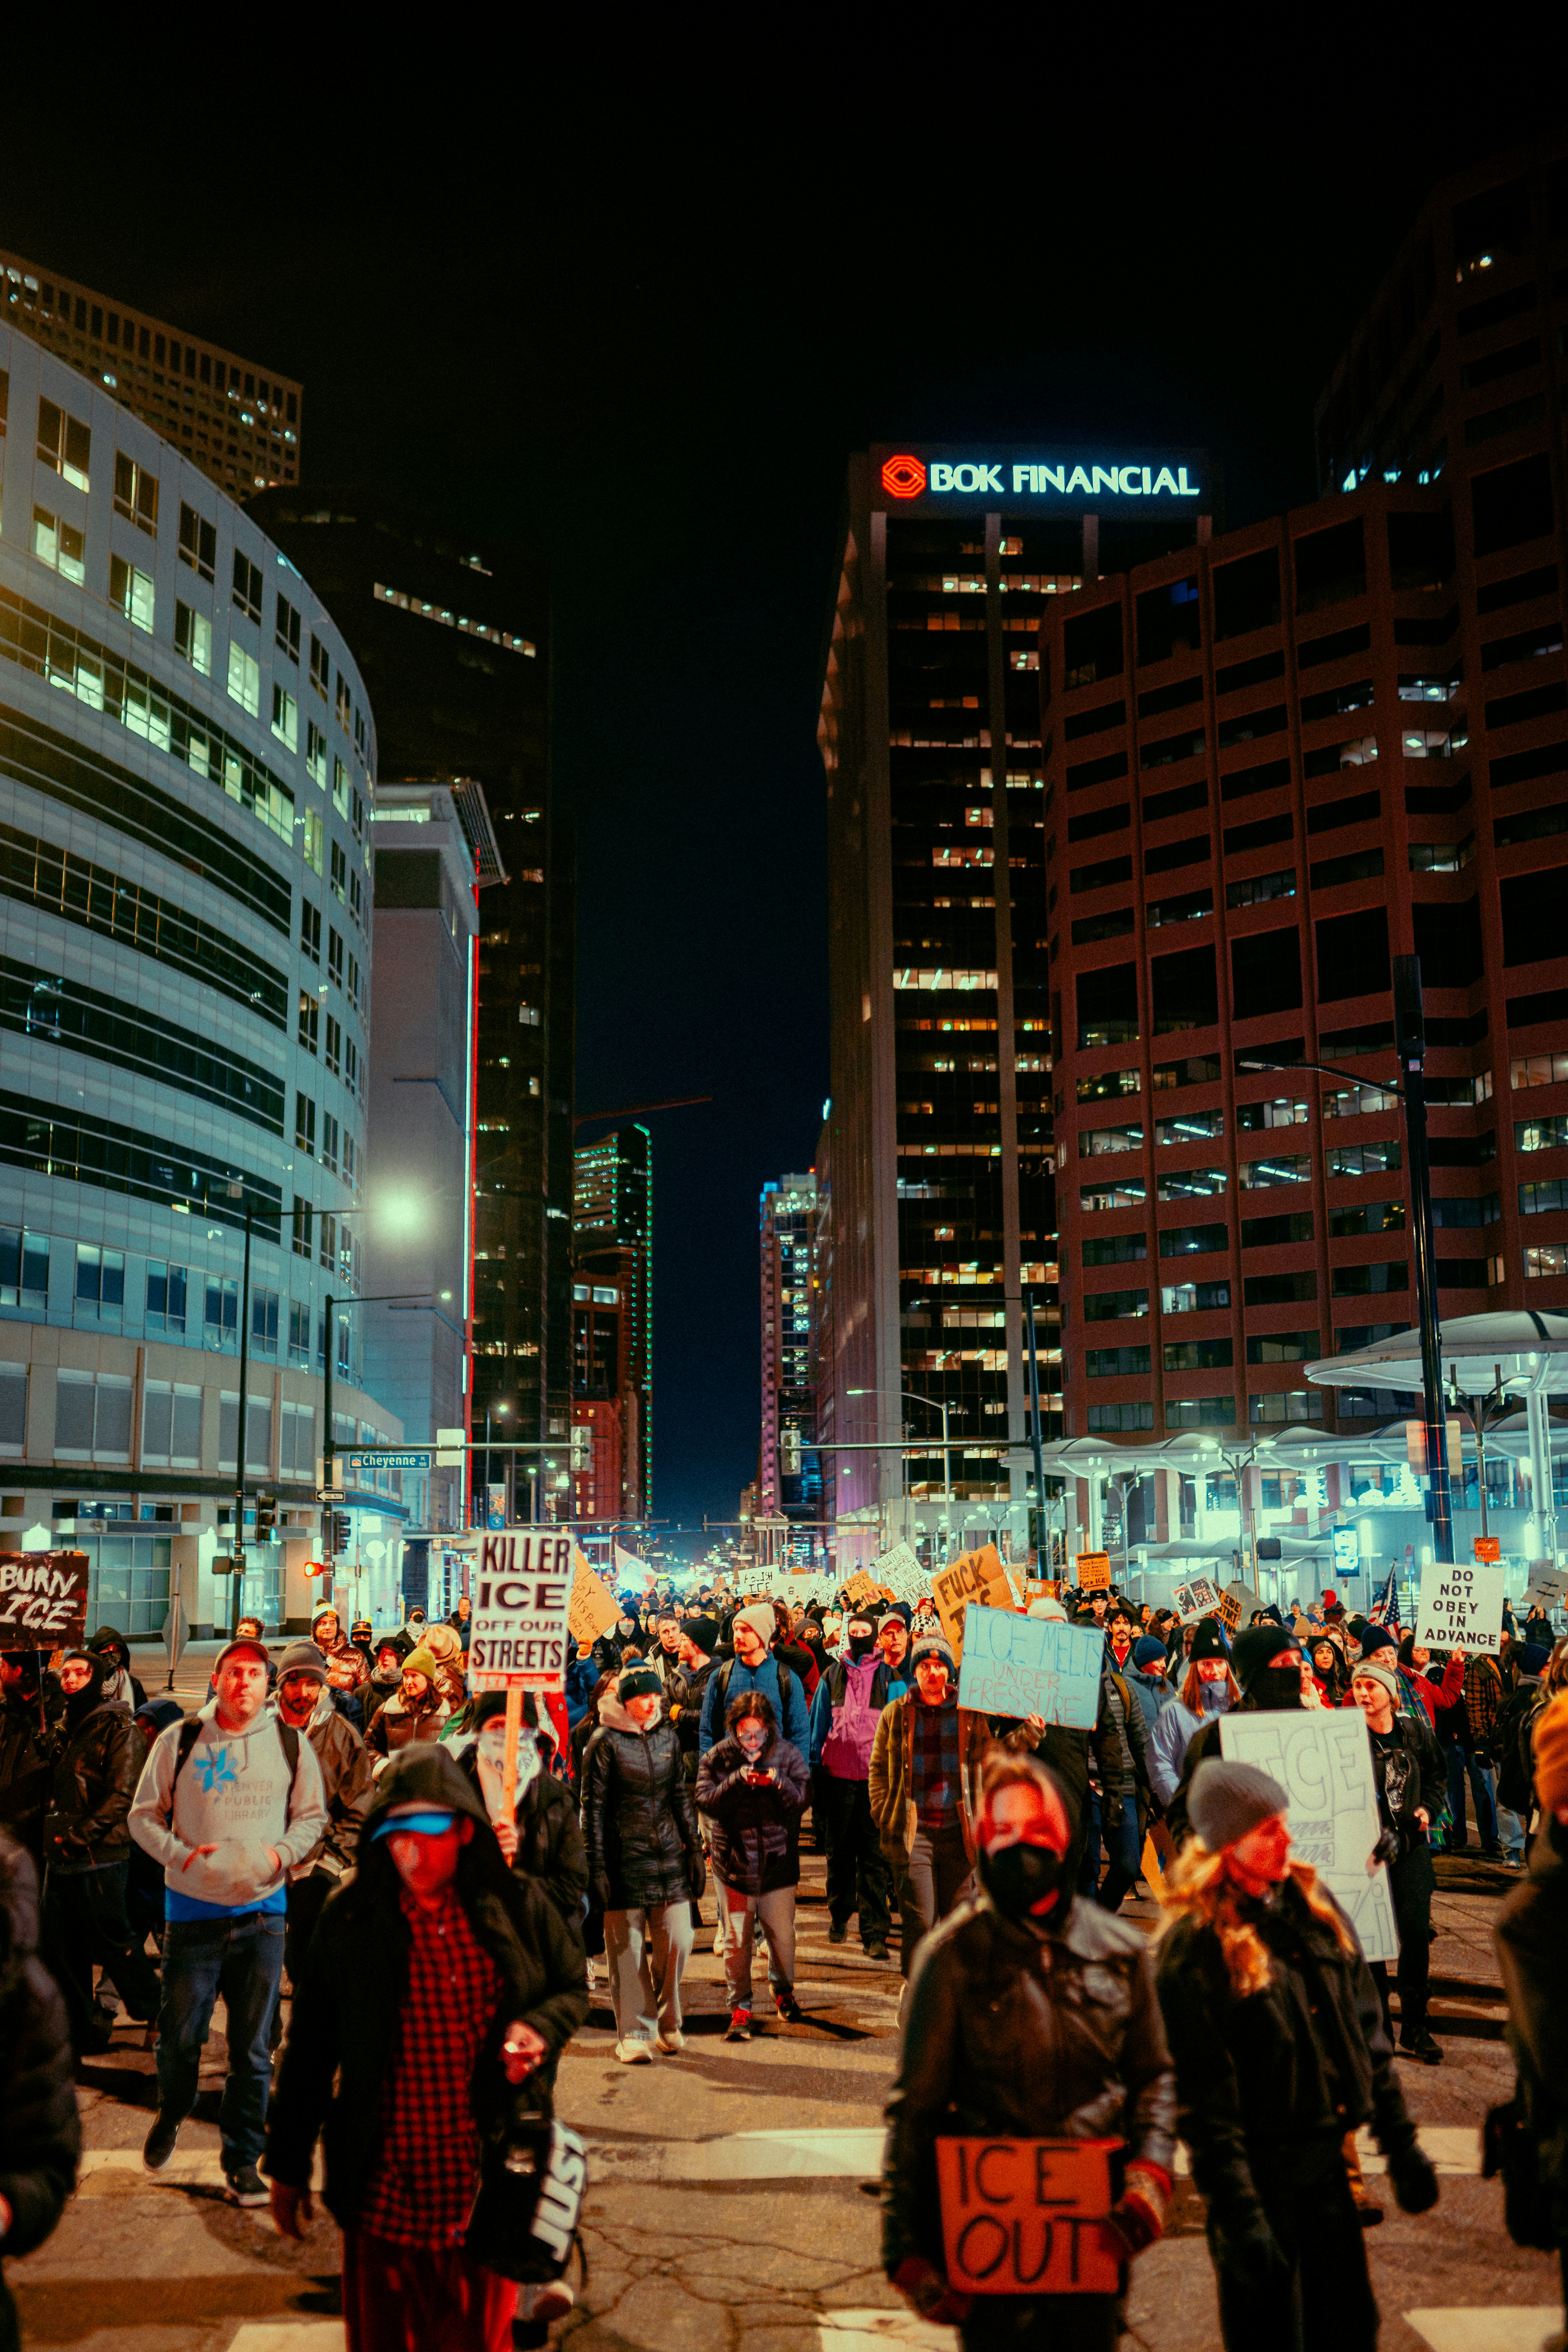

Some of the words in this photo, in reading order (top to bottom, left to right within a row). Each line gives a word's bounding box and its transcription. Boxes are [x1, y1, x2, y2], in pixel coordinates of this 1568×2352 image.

[931, 464, 1004, 492] BOK
[1012, 465, 1200, 495] FINANCIAL
[362, 1455, 416, 1468] Cheyenne
[481, 1537, 570, 1574] KILLER
[877, 1547, 905, 1571] INJUSTICE
[882, 1555, 911, 1577] ANYWHERE
[0, 1564, 79, 1598] BURN
[817, 1577, 833, 1589] ICE
[937, 1554, 989, 1608] FUCK
[1452, 1570, 1474, 1582] DO
[479, 1582, 566, 1610] ICE
[747, 1582, 772, 1593] ICE
[808, 1587, 833, 1601] DOMESTIC
[859, 1582, 867, 1591] 4
[893, 1585, 903, 1594] TO
[1440, 1584, 1473, 1598] NOT
[0, 1593, 79, 1629] ICE
[1224, 1595, 1241, 1613] SIDE
[1433, 1600, 1479, 1614] OBEY
[475, 1620, 515, 1632] OFF
[520, 1620, 563, 1632] OUR
[568, 1612, 584, 1634] NAZI
[1449, 1615, 1466, 1628] IN
[963, 1606, 1031, 1665] ICE
[1040, 1624, 1103, 1678] MELTS
[1424, 1628, 1497, 1647] ADVANCE
[472, 1639, 563, 1669] STREETS
[993, 1661, 1060, 1692] UNDER
[968, 1677, 1082, 1722] PRESSURE
[223, 1780, 273, 1792] DENVER
[225, 1795, 271, 1805] PUBLIC
[224, 1810, 270, 1821] LIBRARY
[959, 2144, 1080, 2206] ICE
[957, 2214, 1107, 2285] OUT
